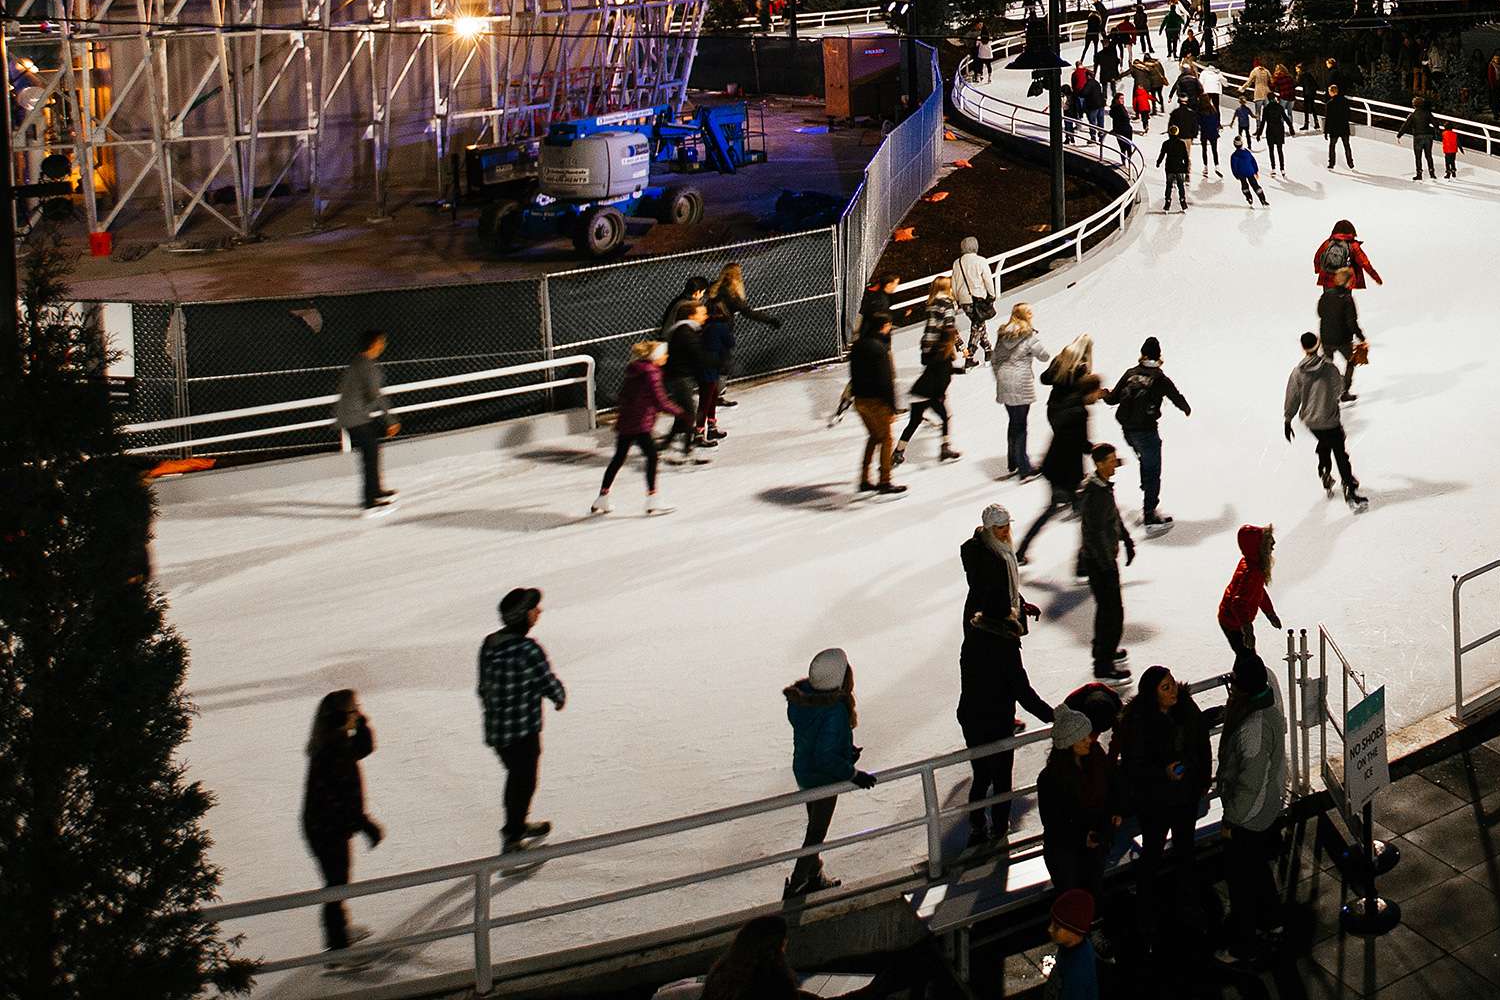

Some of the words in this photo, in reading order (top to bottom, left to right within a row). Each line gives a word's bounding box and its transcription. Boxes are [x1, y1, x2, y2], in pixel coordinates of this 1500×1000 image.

[1350, 744, 1361, 760] NO
[1362, 725, 1384, 750] SHOES
[1357, 758, 1367, 770] ON
[1367, 747, 1378, 764] THE
[1364, 766, 1373, 781] ICE
